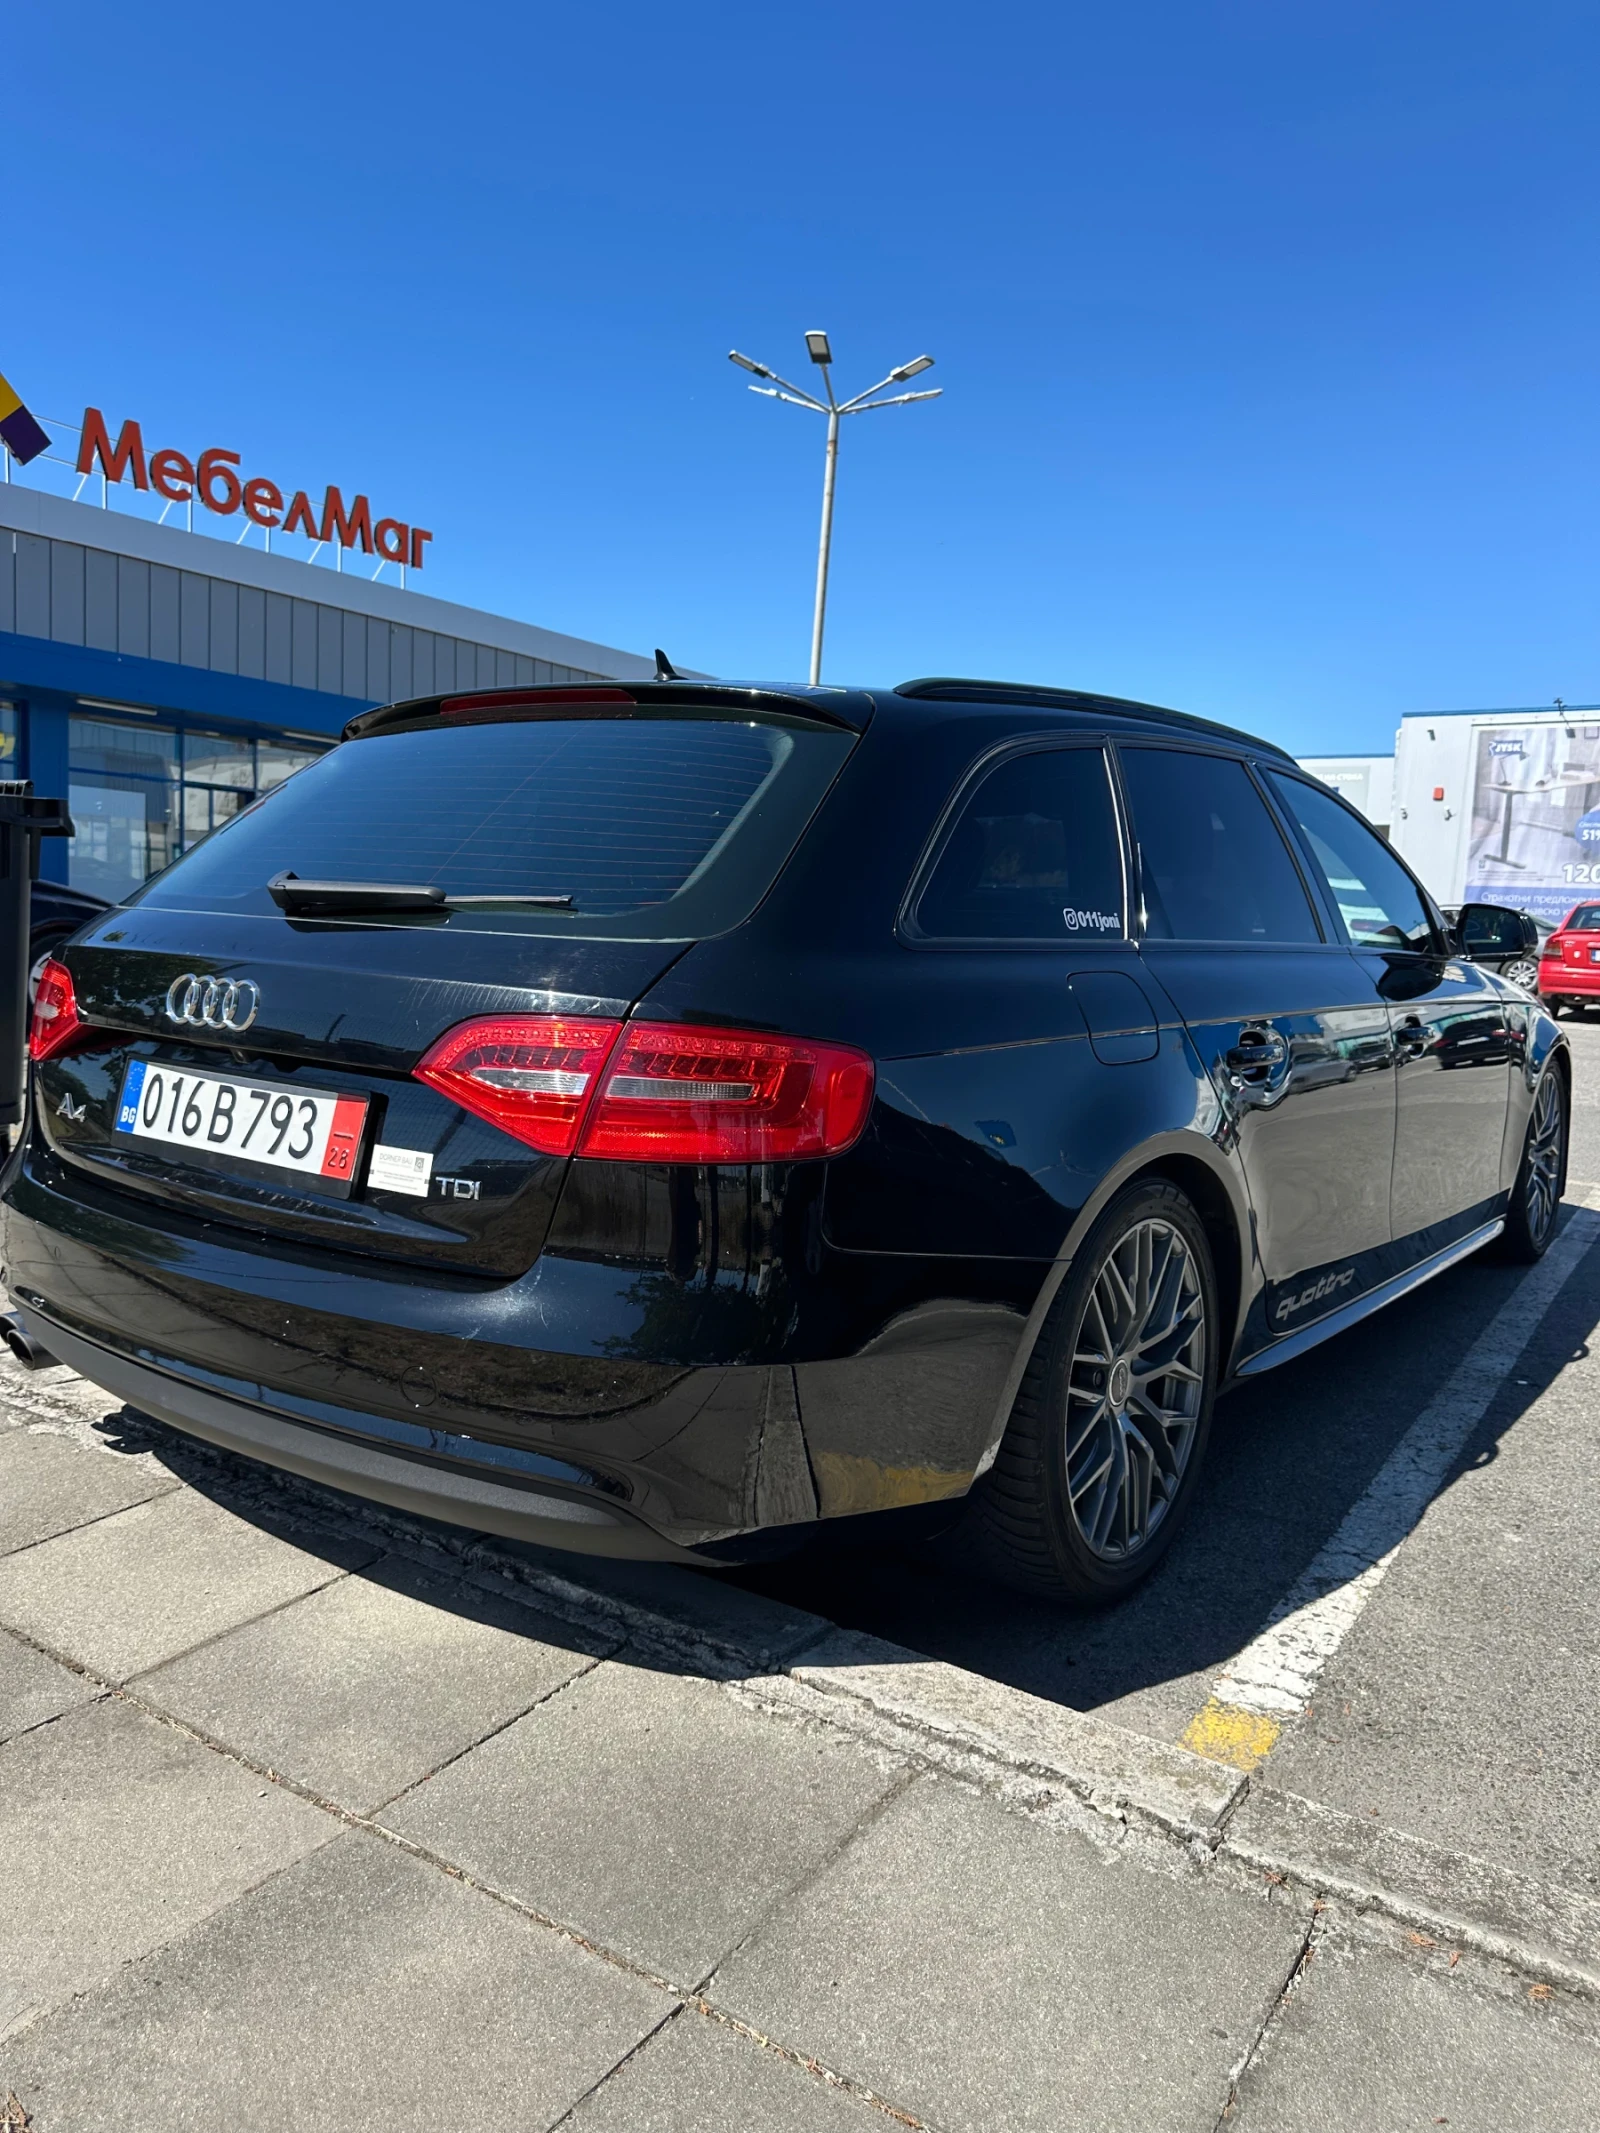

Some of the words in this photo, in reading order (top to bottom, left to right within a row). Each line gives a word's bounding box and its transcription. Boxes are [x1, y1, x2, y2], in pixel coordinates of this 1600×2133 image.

[76, 407, 432, 569] МебелМаг
[1495, 742, 1522, 752] JYSK
[55, 1092, 88, 1123] A4
[120, 1105, 137, 1125] BG
[435, 1176, 482, 1200] TDI
[1275, 1267, 1356, 1321] quattro
